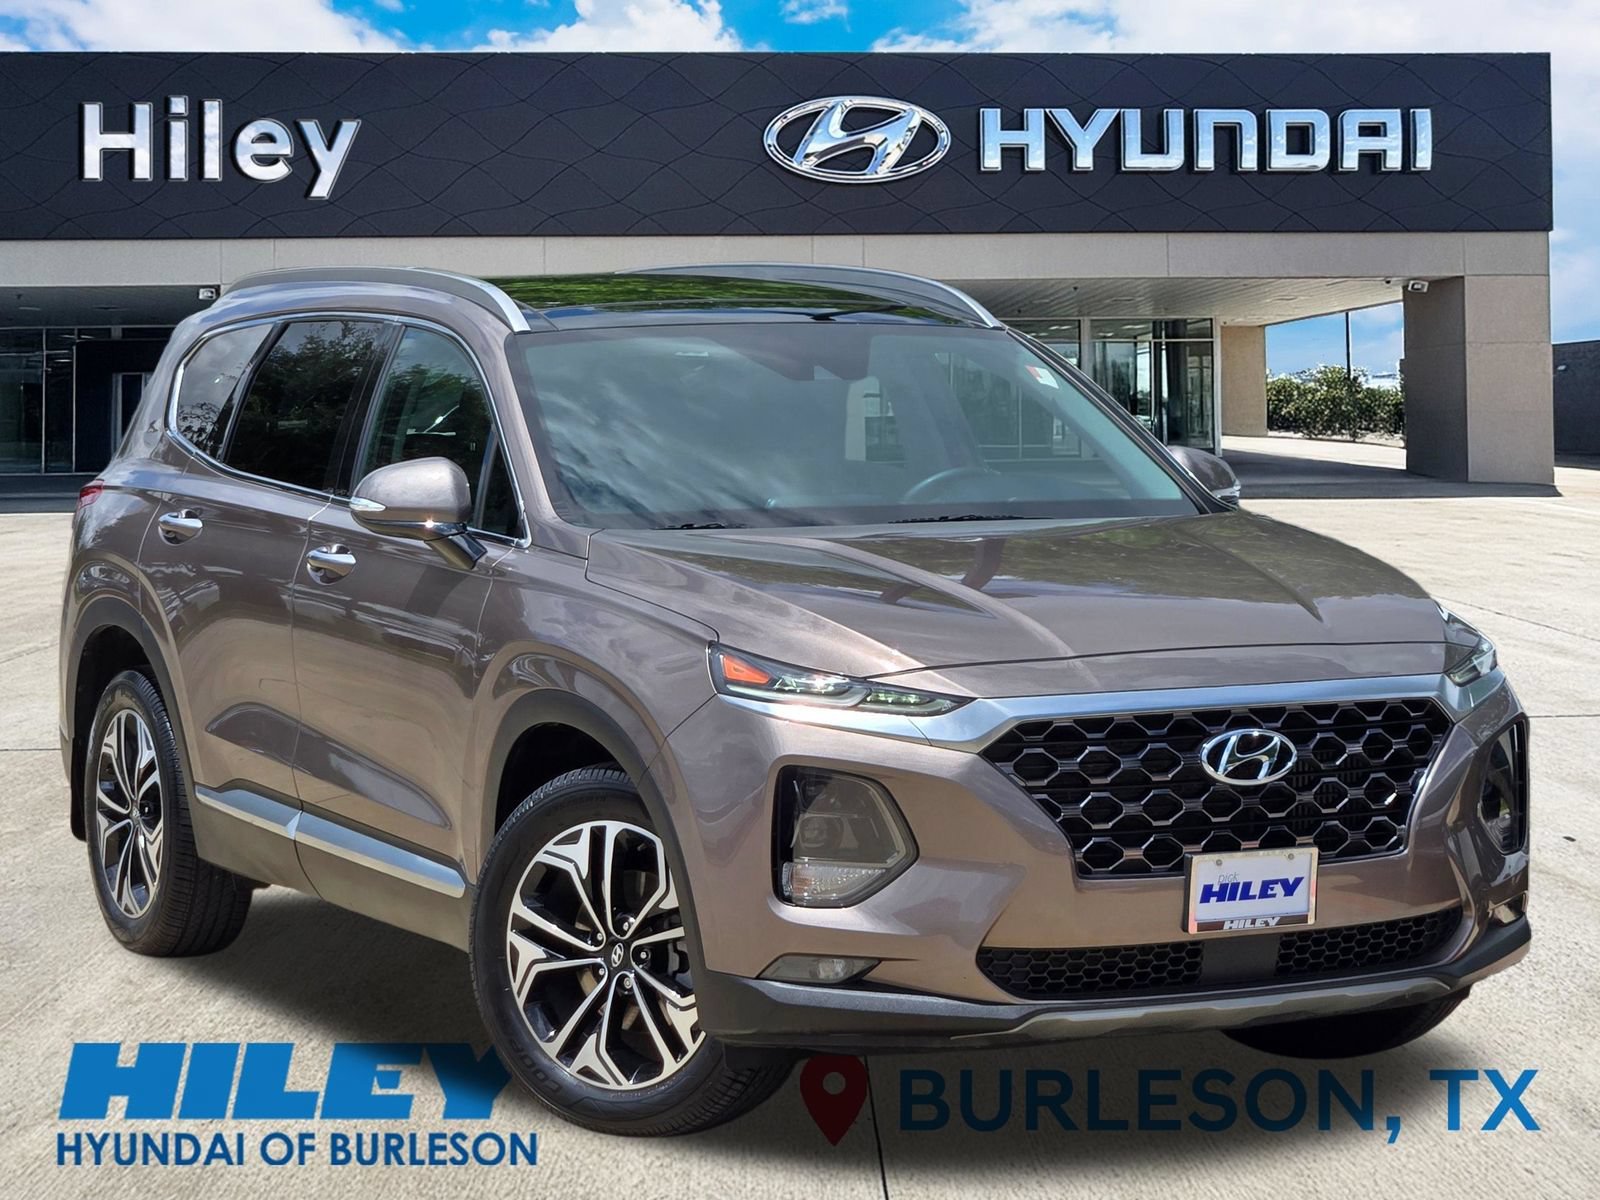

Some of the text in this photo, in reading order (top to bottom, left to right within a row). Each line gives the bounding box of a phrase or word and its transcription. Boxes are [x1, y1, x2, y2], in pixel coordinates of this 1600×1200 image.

[80, 96, 362, 199] Hiley
[979, 107, 1433, 171] HYUNDAI
[1200, 876, 1305, 904] HILEY
[1223, 916, 1281, 930] HILEY
